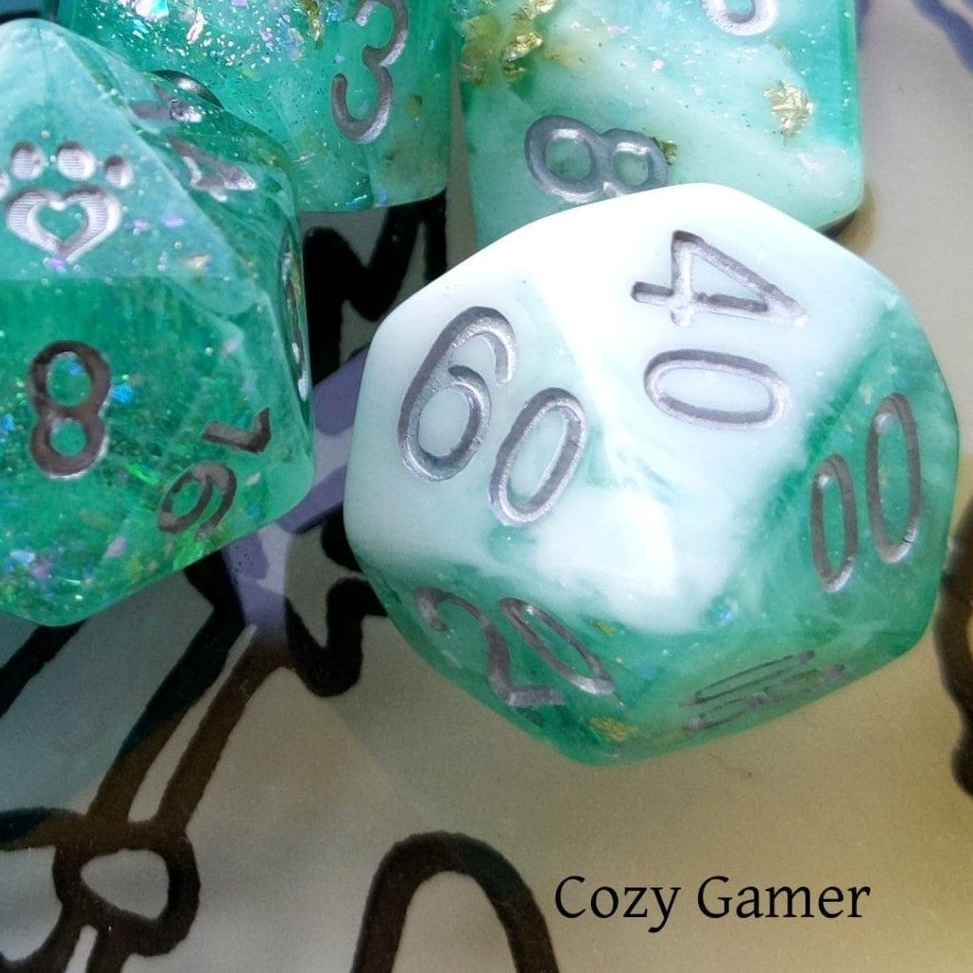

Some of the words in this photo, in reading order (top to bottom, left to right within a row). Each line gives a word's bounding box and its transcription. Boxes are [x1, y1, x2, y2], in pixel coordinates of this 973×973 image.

[524, 114, 670, 204] 8
[29, 340, 113, 482] 8
[397, 305, 587, 528] 60
[630, 229, 810, 432] 40
[809, 392, 922, 595] 00
[415, 586, 616, 708] 20
